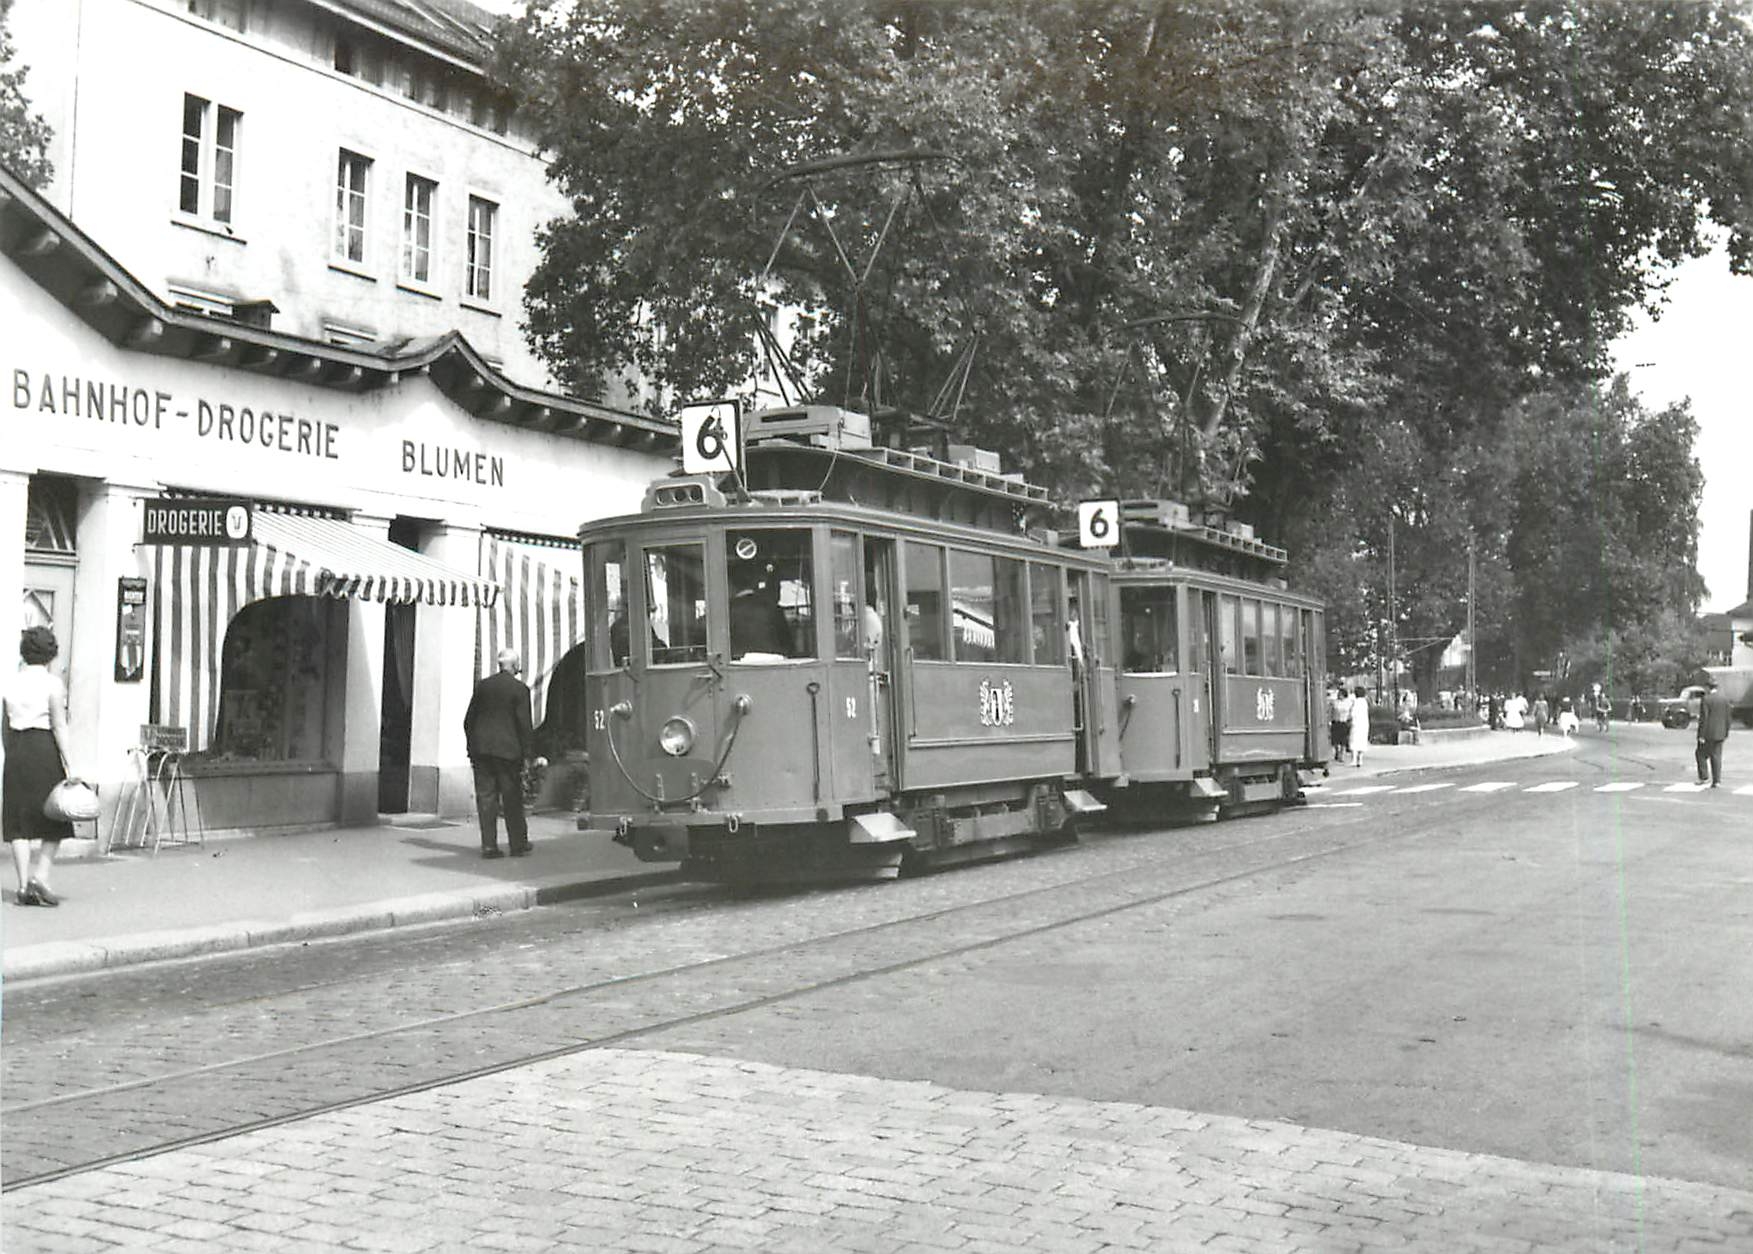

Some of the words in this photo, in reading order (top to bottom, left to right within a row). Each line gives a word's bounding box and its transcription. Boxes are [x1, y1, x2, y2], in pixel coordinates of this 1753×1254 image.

[13, 368, 340, 459] BAHNHOF-DROGERIE
[696, 415, 723, 460] 6
[402, 440, 503, 487] BLUMEN
[147, 509, 223, 536] DROGERIE
[1090, 508, 1109, 539] 6
